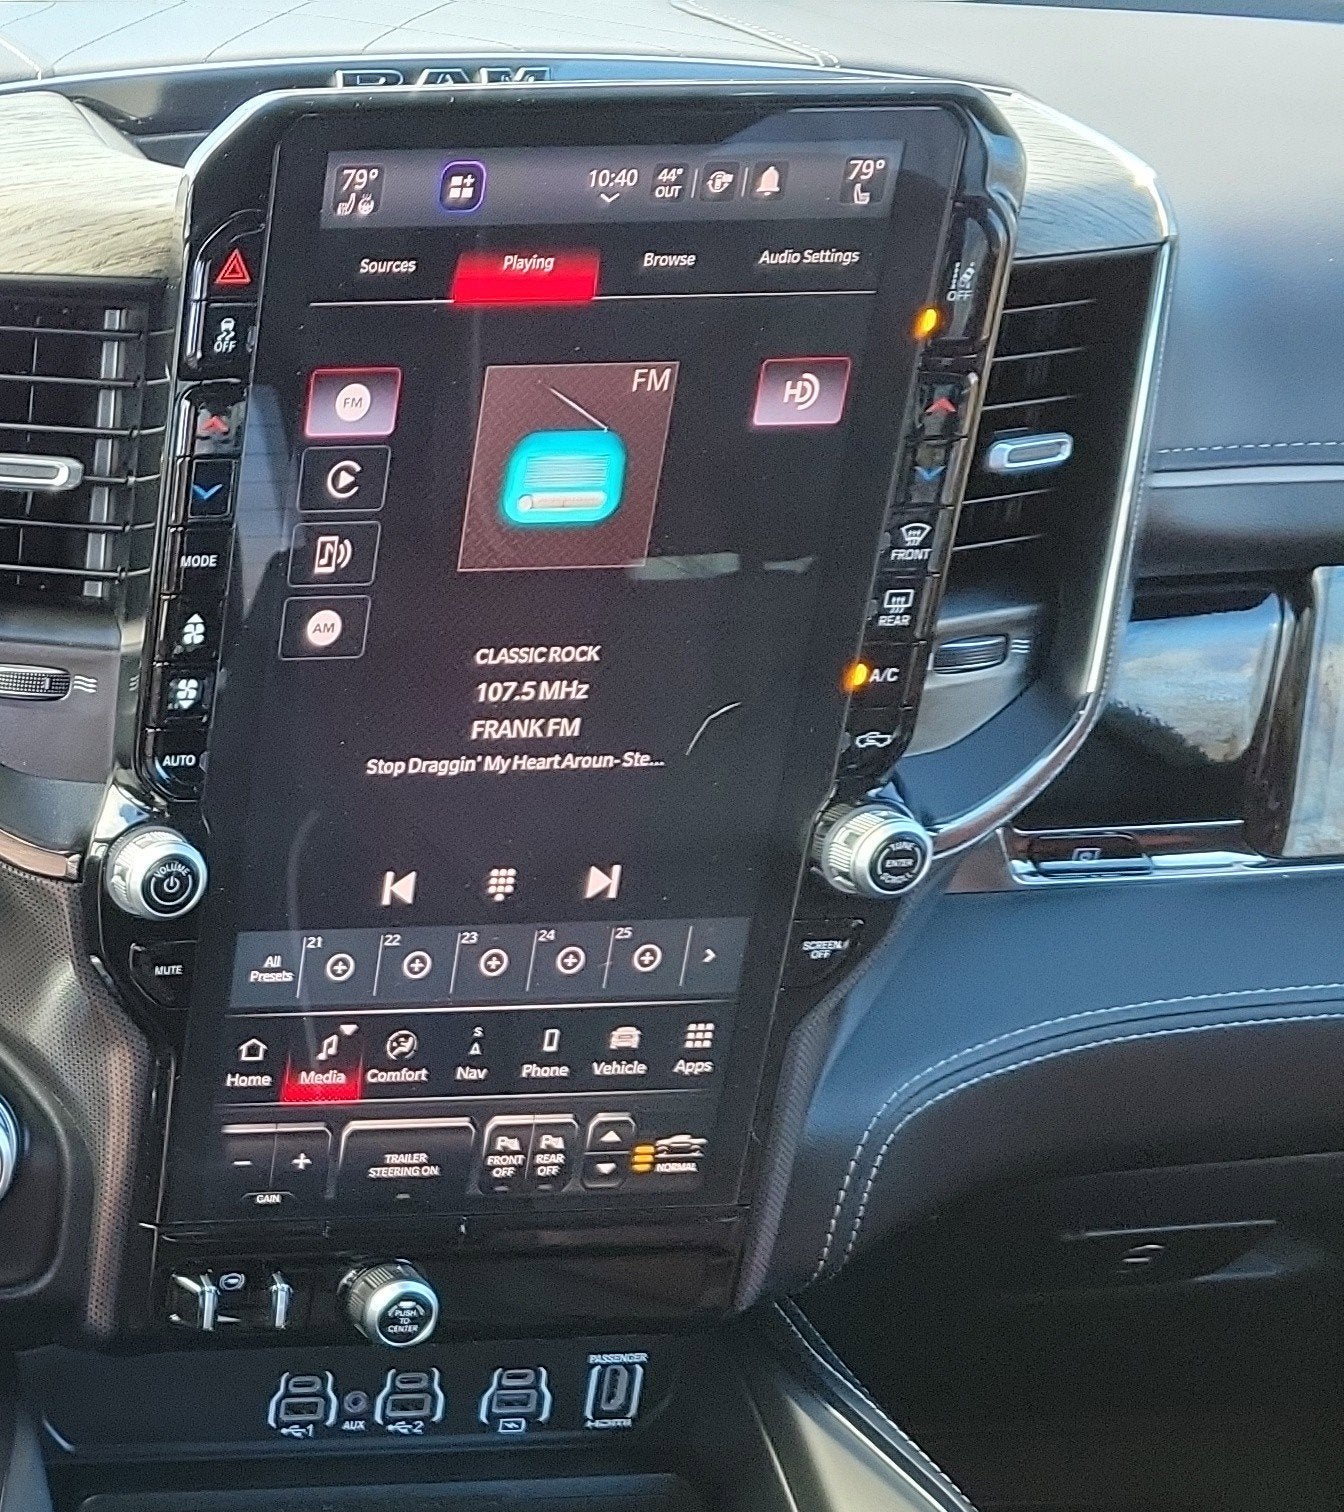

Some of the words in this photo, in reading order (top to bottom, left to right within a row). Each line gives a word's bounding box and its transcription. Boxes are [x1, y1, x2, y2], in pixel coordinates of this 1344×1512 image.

[588, 168, 639, 189] 10:40
[655, 185, 682, 198] OUT
[643, 251, 696, 268] Browse
[759, 248, 801, 265] Audio
[802, 247, 860, 266] Settings
[359, 257, 417, 275] Sources
[503, 254, 555, 273] Playing
[213, 340, 237, 353] OFF
[631, 368, 673, 393] FM
[343, 396, 363, 409] FM
[180, 554, 218, 568] MODE
[890, 549, 932, 561] FRONT
[878, 614, 910, 627] REAR
[313, 622, 335, 633] AM
[475, 646, 547, 664] CLASSIC
[548, 645, 602, 663] ROCK
[869, 668, 900, 683] A/C
[476, 680, 537, 702] 107.5
[538, 679, 590, 700] MHz
[470, 718, 545, 740] FRANK
[546, 717, 582, 738] FM
[162, 754, 196, 768] AUTO
[365, 759, 406, 777] Stop
[484, 755, 511, 775] My
[512, 754, 561, 772] Heart
[153, 862, 191, 879] VOLUME
[460, 931, 479, 945] 23
[537, 929, 556, 942] 24
[614, 927, 633, 940] 25
[306, 936, 323, 949] 21
[383, 934, 401, 947] 22
[263, 955, 282, 968] All
[154, 964, 183, 976] MUTE
[249, 970, 295, 983] Presets
[456, 1066, 488, 1080] Nav
[521, 1065, 570, 1078] Phone
[592, 1061, 647, 1076] Vehicle
[673, 1059, 713, 1074] Apps
[225, 1073, 272, 1088] Home
[300, 1070, 346, 1085] Media
[367, 1068, 429, 1083] Comfort
[384, 1152, 428, 1164] TRAILER
[486, 1154, 526, 1167] FRONT
[535, 1153, 566, 1164] REAR
[368, 1165, 420, 1178] STEERING
[421, 1165, 440, 1177] ON
[492, 1167, 516, 1178] OFF
[537, 1165, 561, 1177] OFF
[656, 1162, 698, 1173] NORMAL
[256, 1193, 282, 1204] GAIN
[394, 1309, 417, 1317] PUSH
[399, 1317, 411, 1325] TO
[387, 1324, 419, 1334] CENTER
[588, 1352, 649, 1364] PASSENGER
[341, 1420, 366, 1431] AUX
